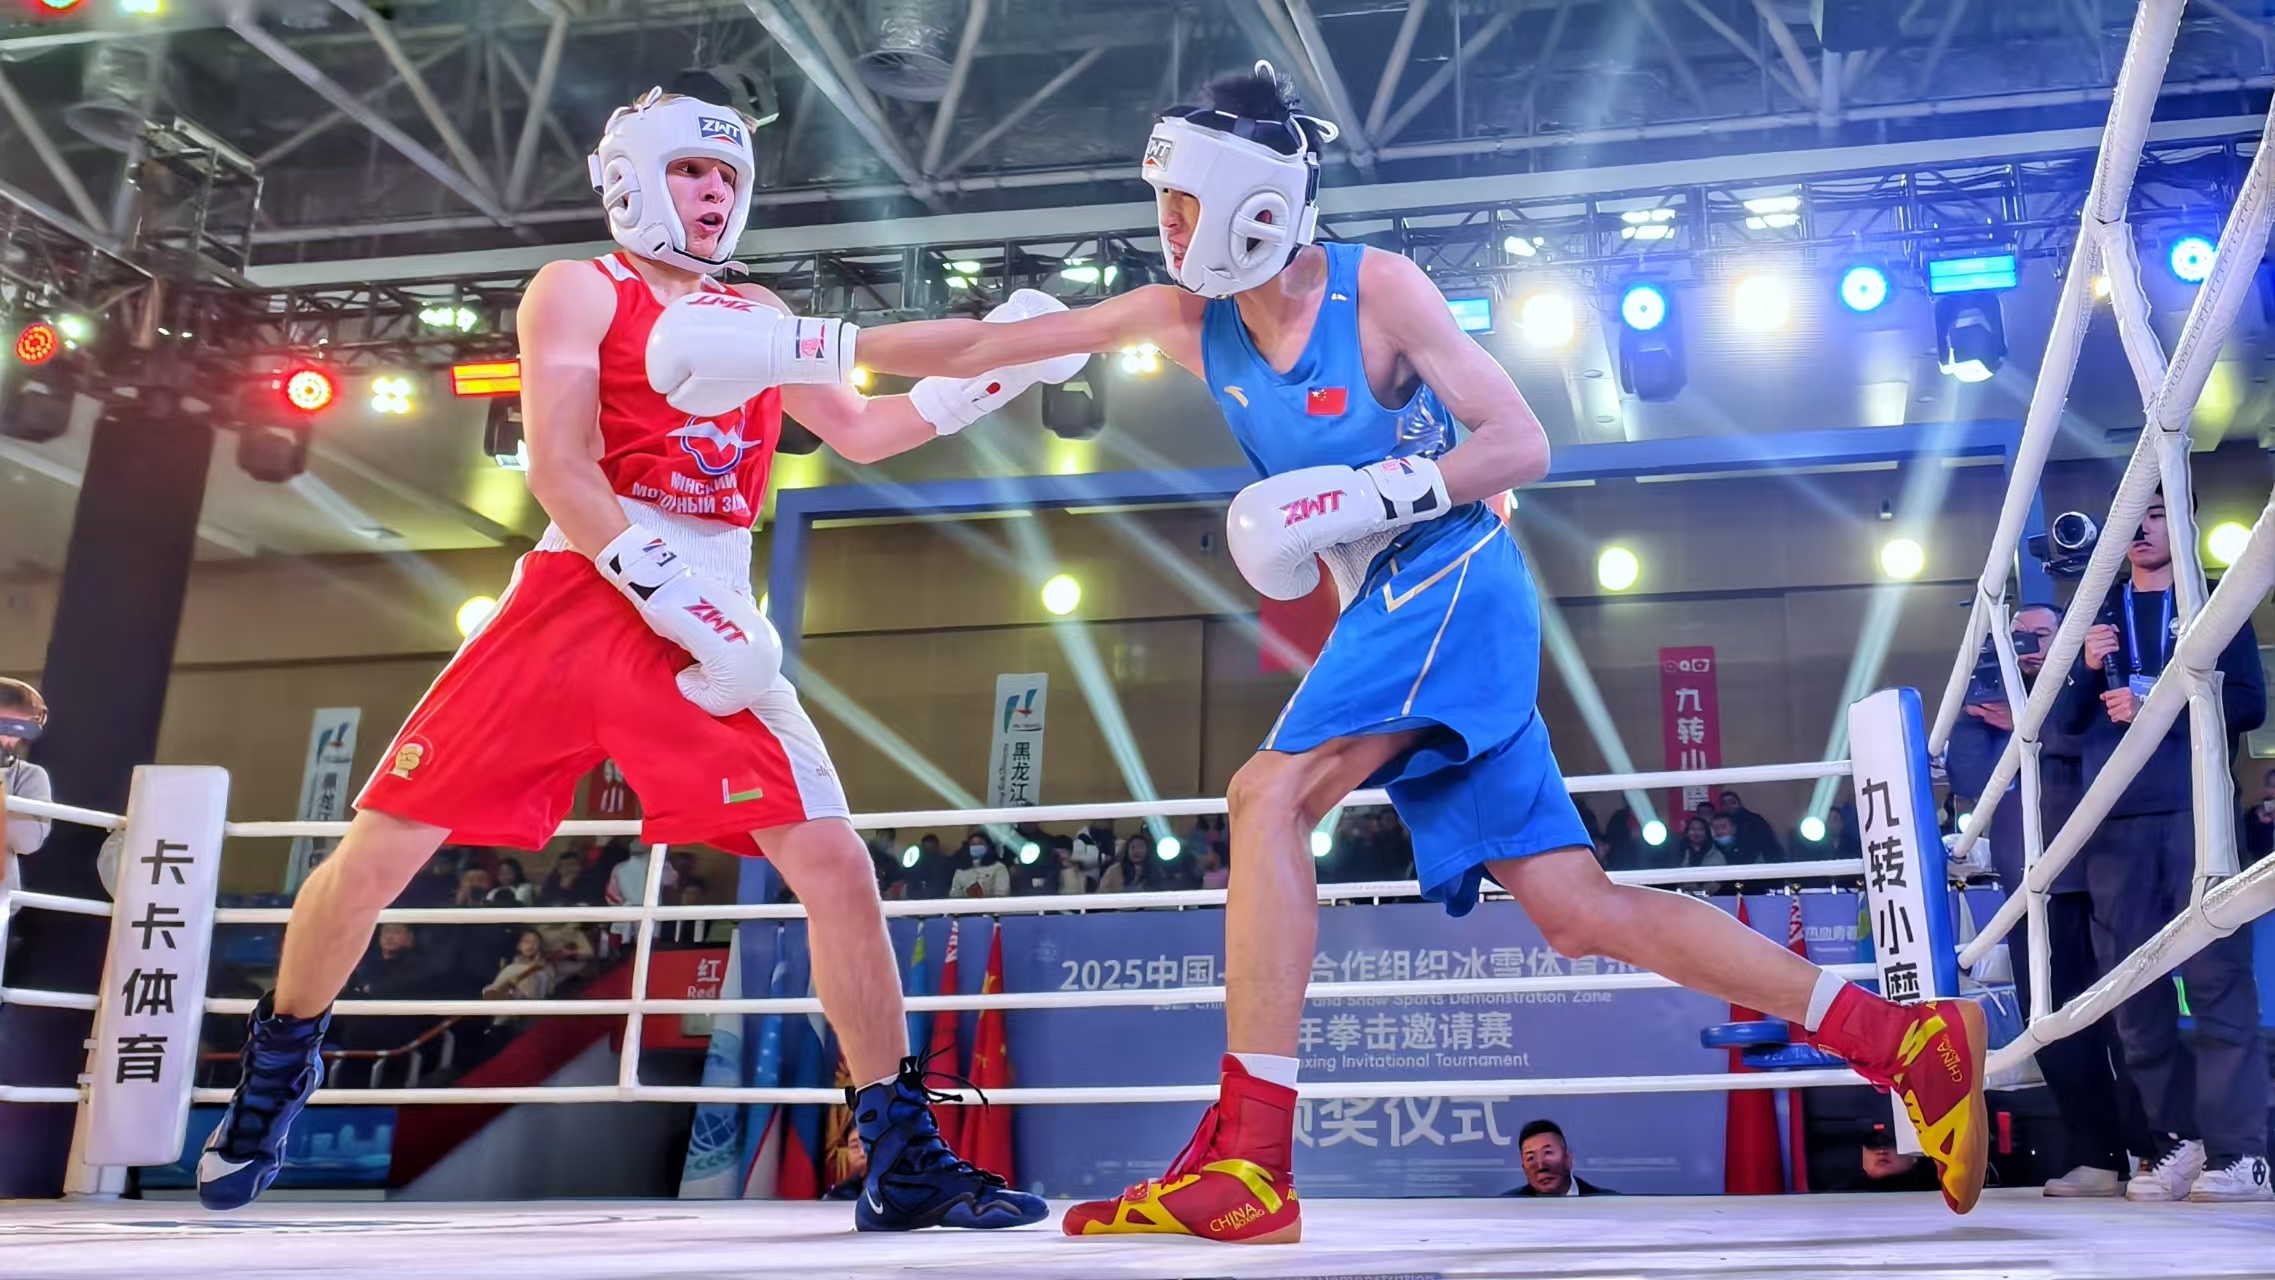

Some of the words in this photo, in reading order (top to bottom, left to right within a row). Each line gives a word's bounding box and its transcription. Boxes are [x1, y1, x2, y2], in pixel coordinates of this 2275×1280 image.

[701, 119, 740, 138] ZWT
[1279, 489, 1347, 528] ZWT
[683, 596, 748, 645] ZWT
[1010, 741, 1037, 807] 黑龙江
[115, 839, 195, 1084] 卡卡体育
[696, 957, 722, 982] 红
[687, 984, 717, 999] Red
[1299, 1054, 1337, 1072] xing
[1342, 1053, 1430, 1068] Invitational
[1435, 1052, 1530, 1068] Tournament
[1937, 1042, 1963, 1082] CHINA
[1210, 1203, 1257, 1232] CHINA
